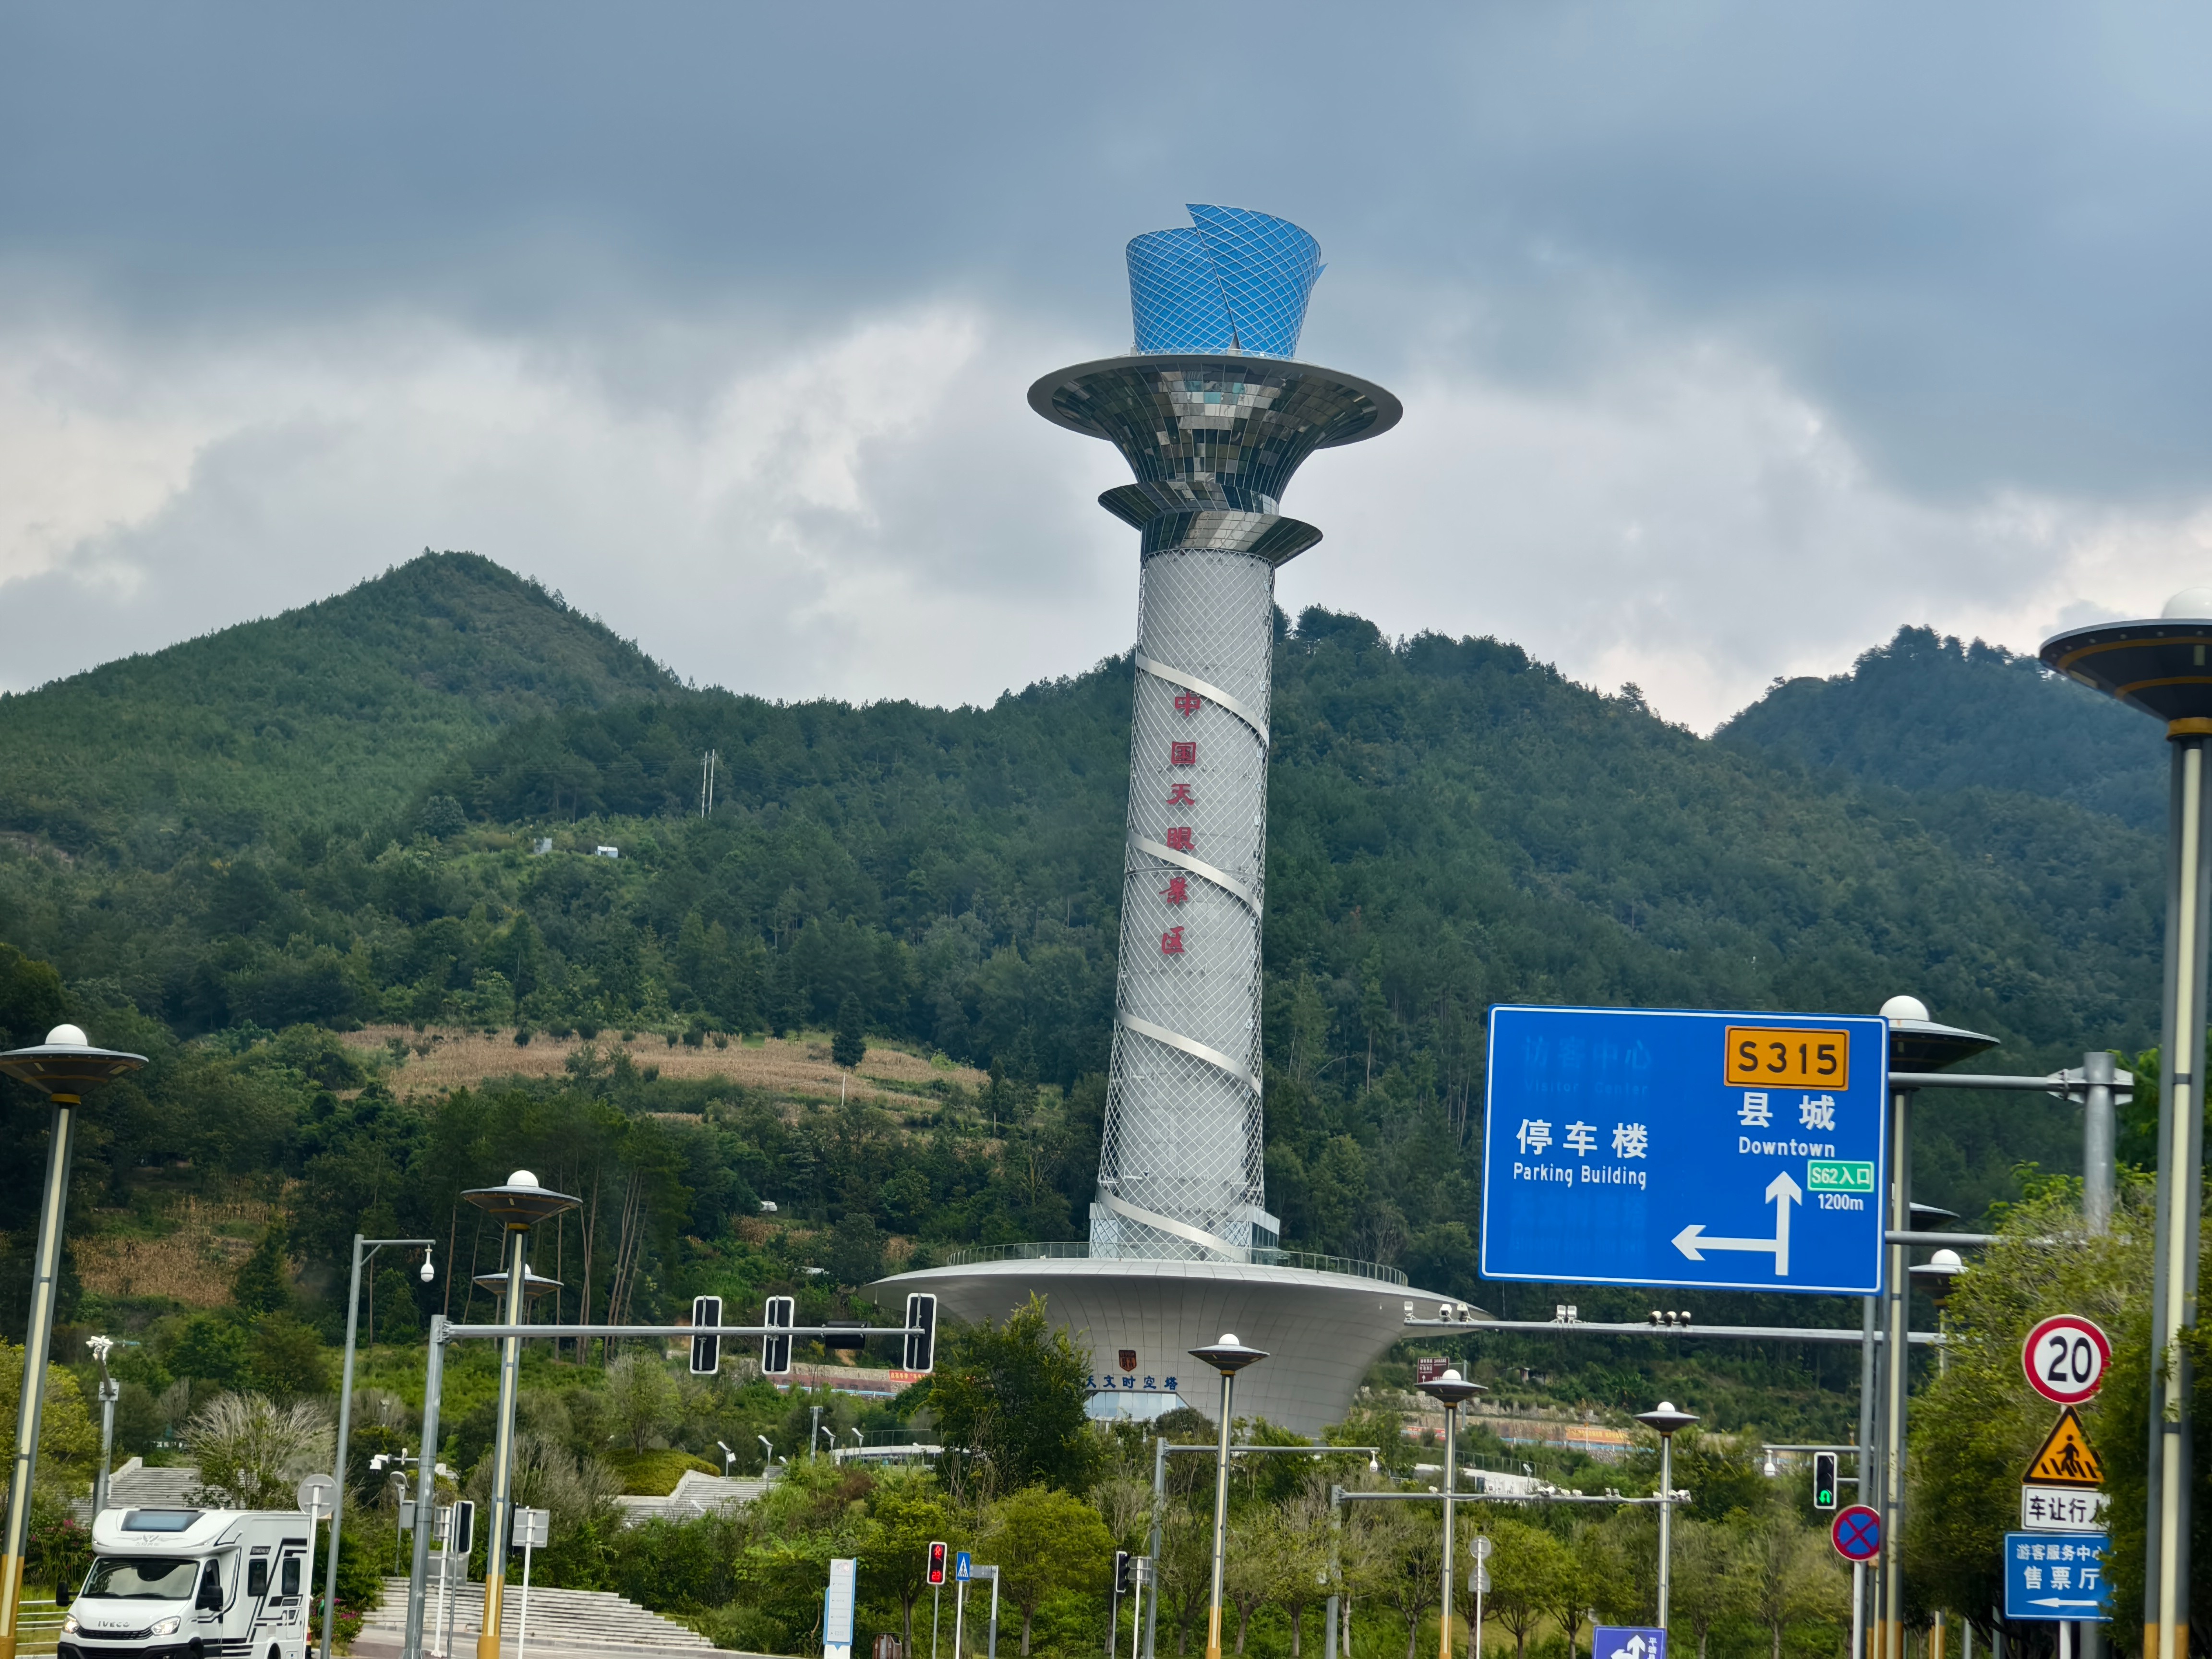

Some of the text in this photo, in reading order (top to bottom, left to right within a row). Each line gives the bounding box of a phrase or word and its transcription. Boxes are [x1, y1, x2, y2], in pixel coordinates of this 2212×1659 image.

[1159, 691, 1201, 954] 中国天眼景区
[1738, 1041, 1838, 1075] S315
[1737, 1092, 1836, 1131] 县城
[1516, 1118, 1648, 1159] 停车楼
[1739, 1136, 1835, 1158] Downtown
[1514, 1162, 1647, 1190] Parking Building
[1812, 1166, 1870, 1185] S62入口
[1817, 1193, 1864, 1211] 1200m
[2047, 1335, 2092, 1383] 20
[1086, 1375, 1178, 1390] 天文时空塔
[2023, 1565, 2100, 1590] 售票厅
